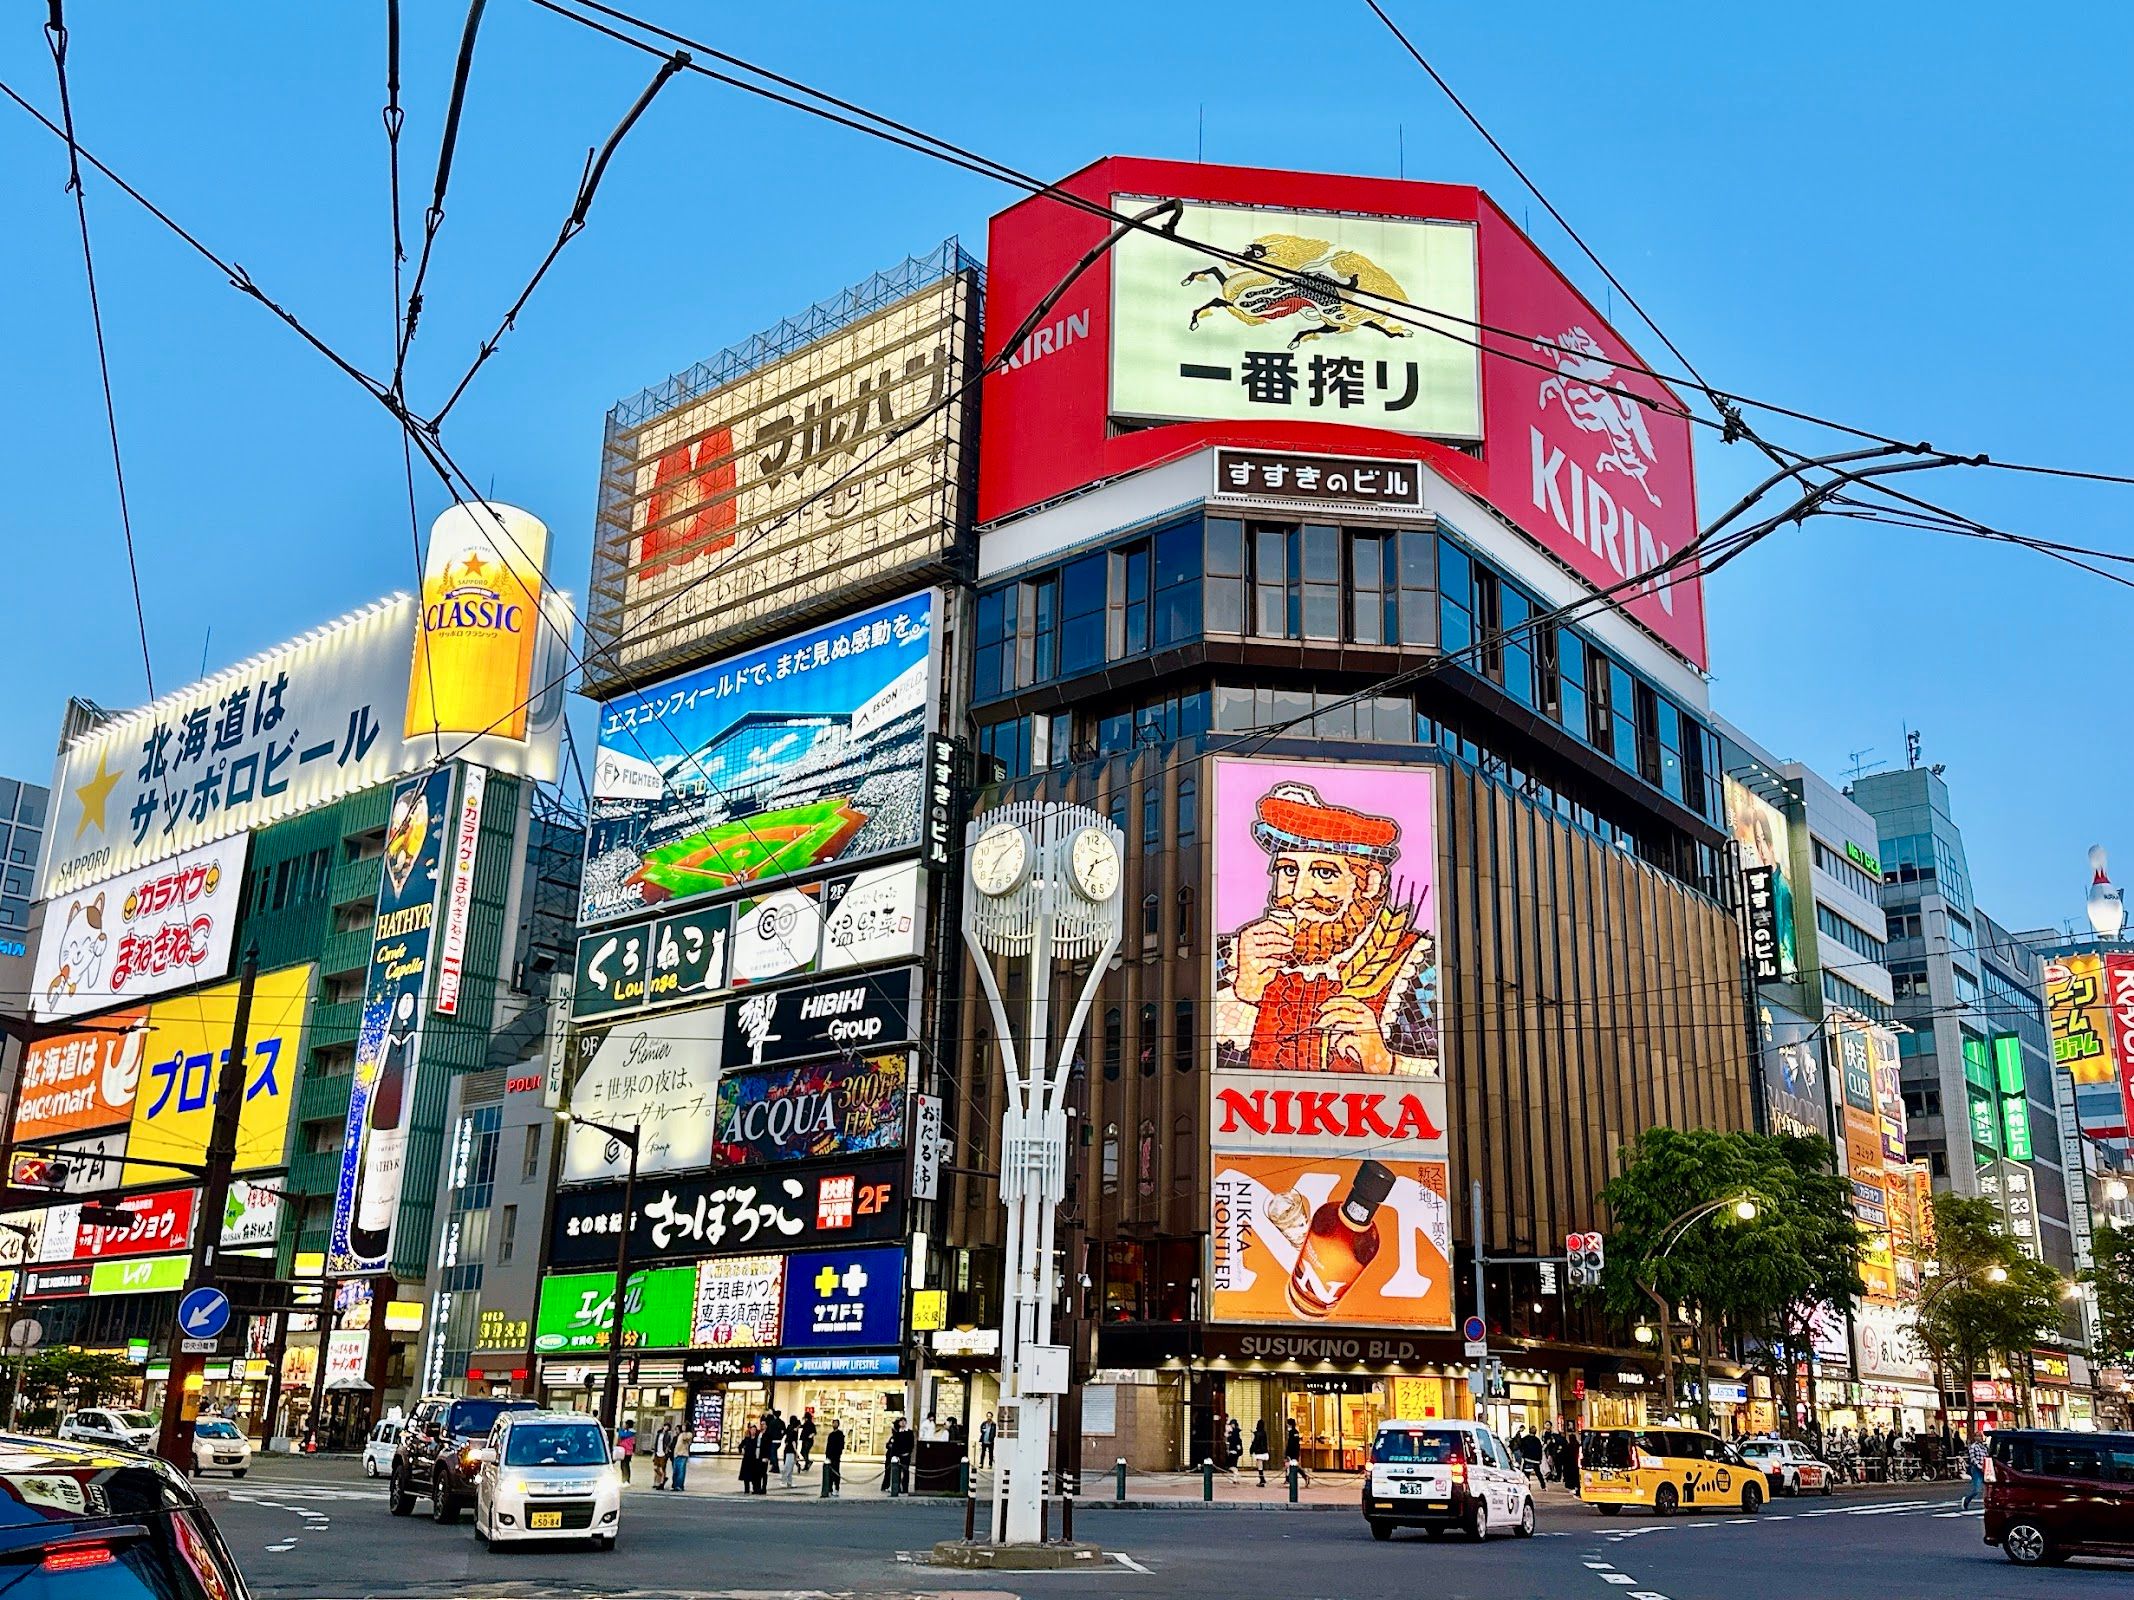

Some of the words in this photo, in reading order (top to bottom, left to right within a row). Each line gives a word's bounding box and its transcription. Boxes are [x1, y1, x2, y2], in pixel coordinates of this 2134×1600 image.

[1180, 351, 1419, 411] 一番搾り
[1229, 461, 1408, 497] すすきのビル
[1530, 424, 1674, 617] KIRIN
[426, 600, 523, 633] CLASSIC
[606, 613, 922, 736] エスコンフィールドで、まだ見ぬ感動を。
[137, 672, 289, 784] 北海道は
[130, 704, 380, 848] サッポロビール
[930, 741, 954, 864] すすきのビル
[461, 807, 478, 860] カラオケ
[58, 846, 111, 881] SAPPORO
[137, 868, 207, 915] カラオケ
[450, 876, 469, 951] まねきねこ
[594, 881, 646, 909] VILLAGE
[829, 884, 846, 900] 2F
[375, 902, 433, 941] HATHYR
[1750, 871, 1776, 977] すすきのビル
[111, 914, 214, 993] まねきねこ
[588, 923, 705, 992] くろねこ
[613, 972, 678, 1001] Lounge
[800, 988, 866, 1020] HIBIKI
[581, 1037, 599, 1057] 9F
[738, 992, 781, 1066] 響
[827, 1017, 882, 1041] Group
[22, 1036, 99, 1089] 北海道は
[1848, 1072, 1870, 1099] CLUB
[576, 1093, 711, 1133] ティーグループ。
[720, 1093, 837, 1146] ACQUA
[1216, 1087, 1443, 1140] NIKKA
[644, 1178, 804, 1250] さっぽろっこ
[857, 1184, 891, 1214] 2F
[1236, 1181, 1252, 1253] NIKKA
[1214, 1182, 1231, 1291] FRONTIER
[123, 1263, 152, 1286] レイク
[702, 1279, 769, 1301] 元祖串かつ
[700, 1301, 776, 1323] 恵美須商店
[1240, 1336, 1360, 1359] SUSUKINO
[1368, 1339, 1420, 1359] BLD.
